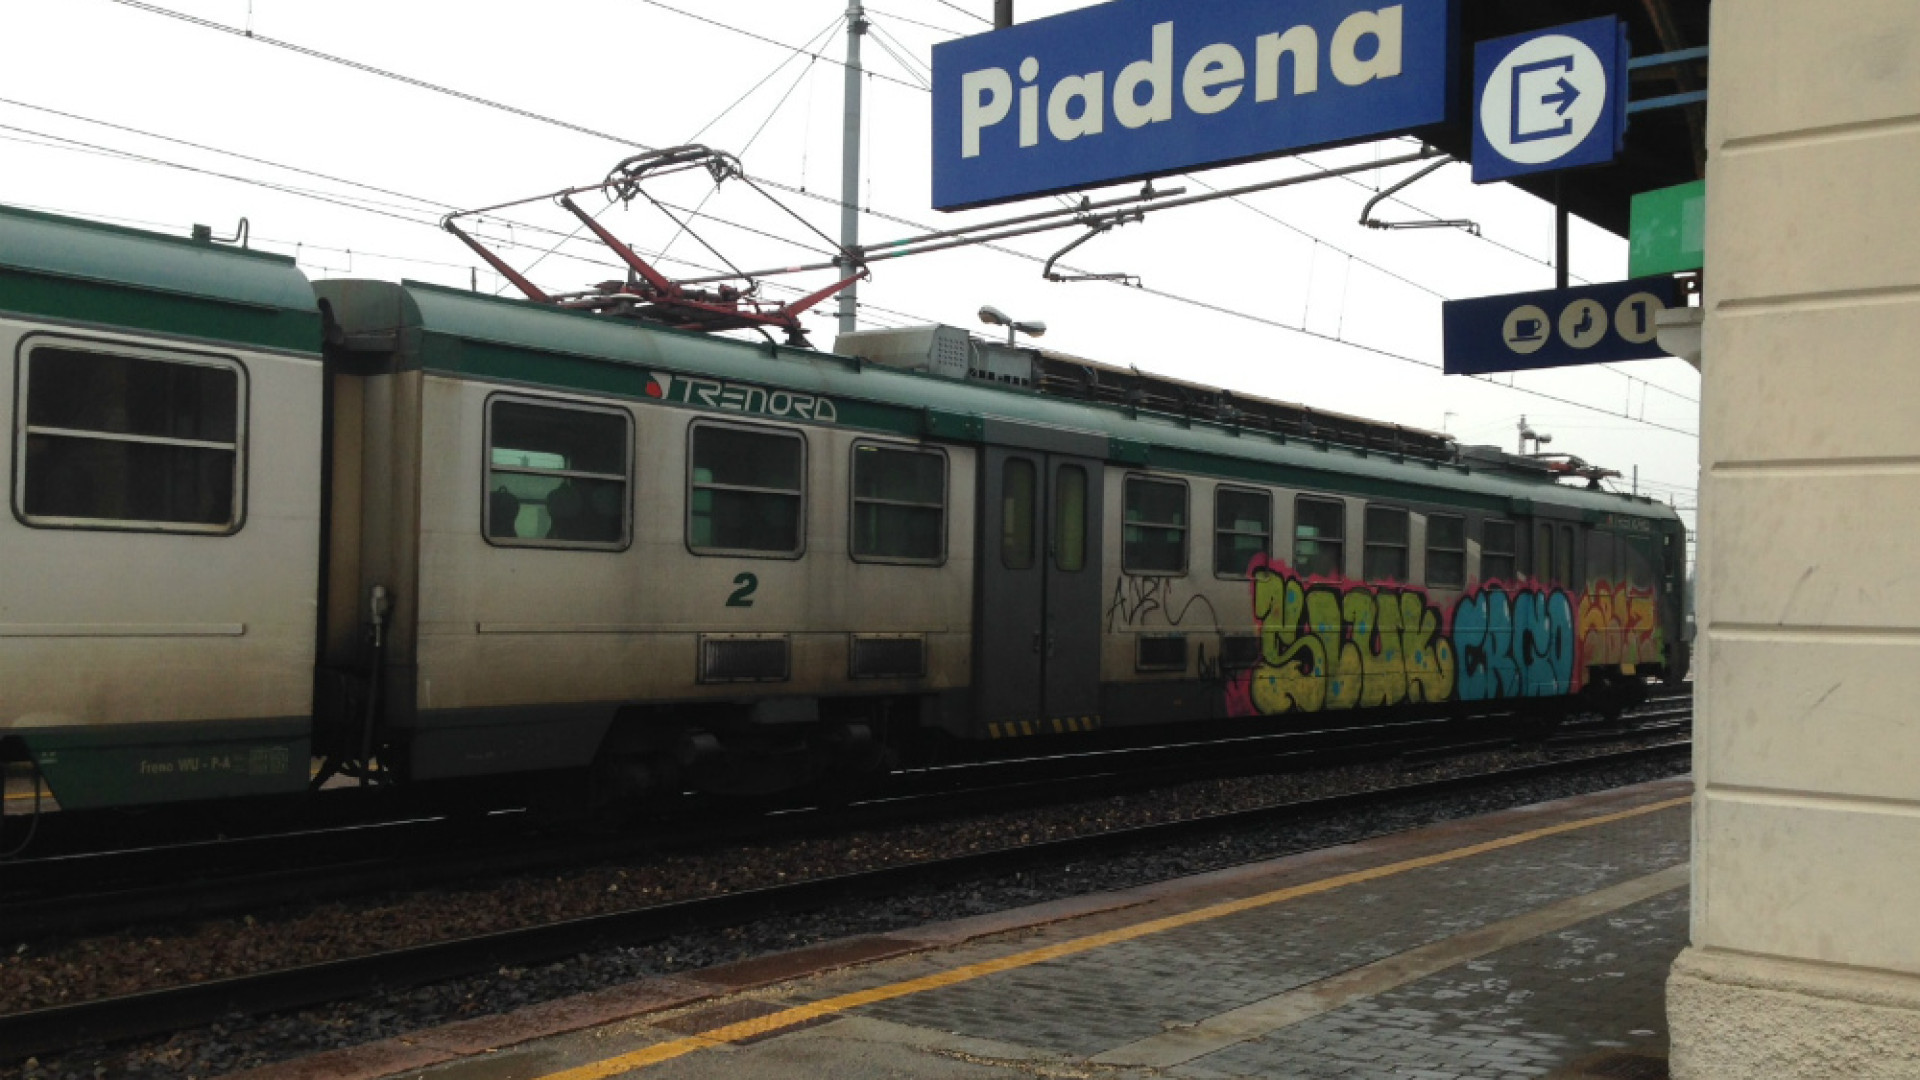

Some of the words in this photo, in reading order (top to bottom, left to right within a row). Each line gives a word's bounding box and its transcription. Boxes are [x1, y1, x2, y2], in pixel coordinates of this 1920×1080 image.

[961, 5, 1402, 158] Piadena
[1632, 301, 1646, 335] 1
[675, 375, 837, 423] TRENORD
[725, 571, 758, 607] 2
